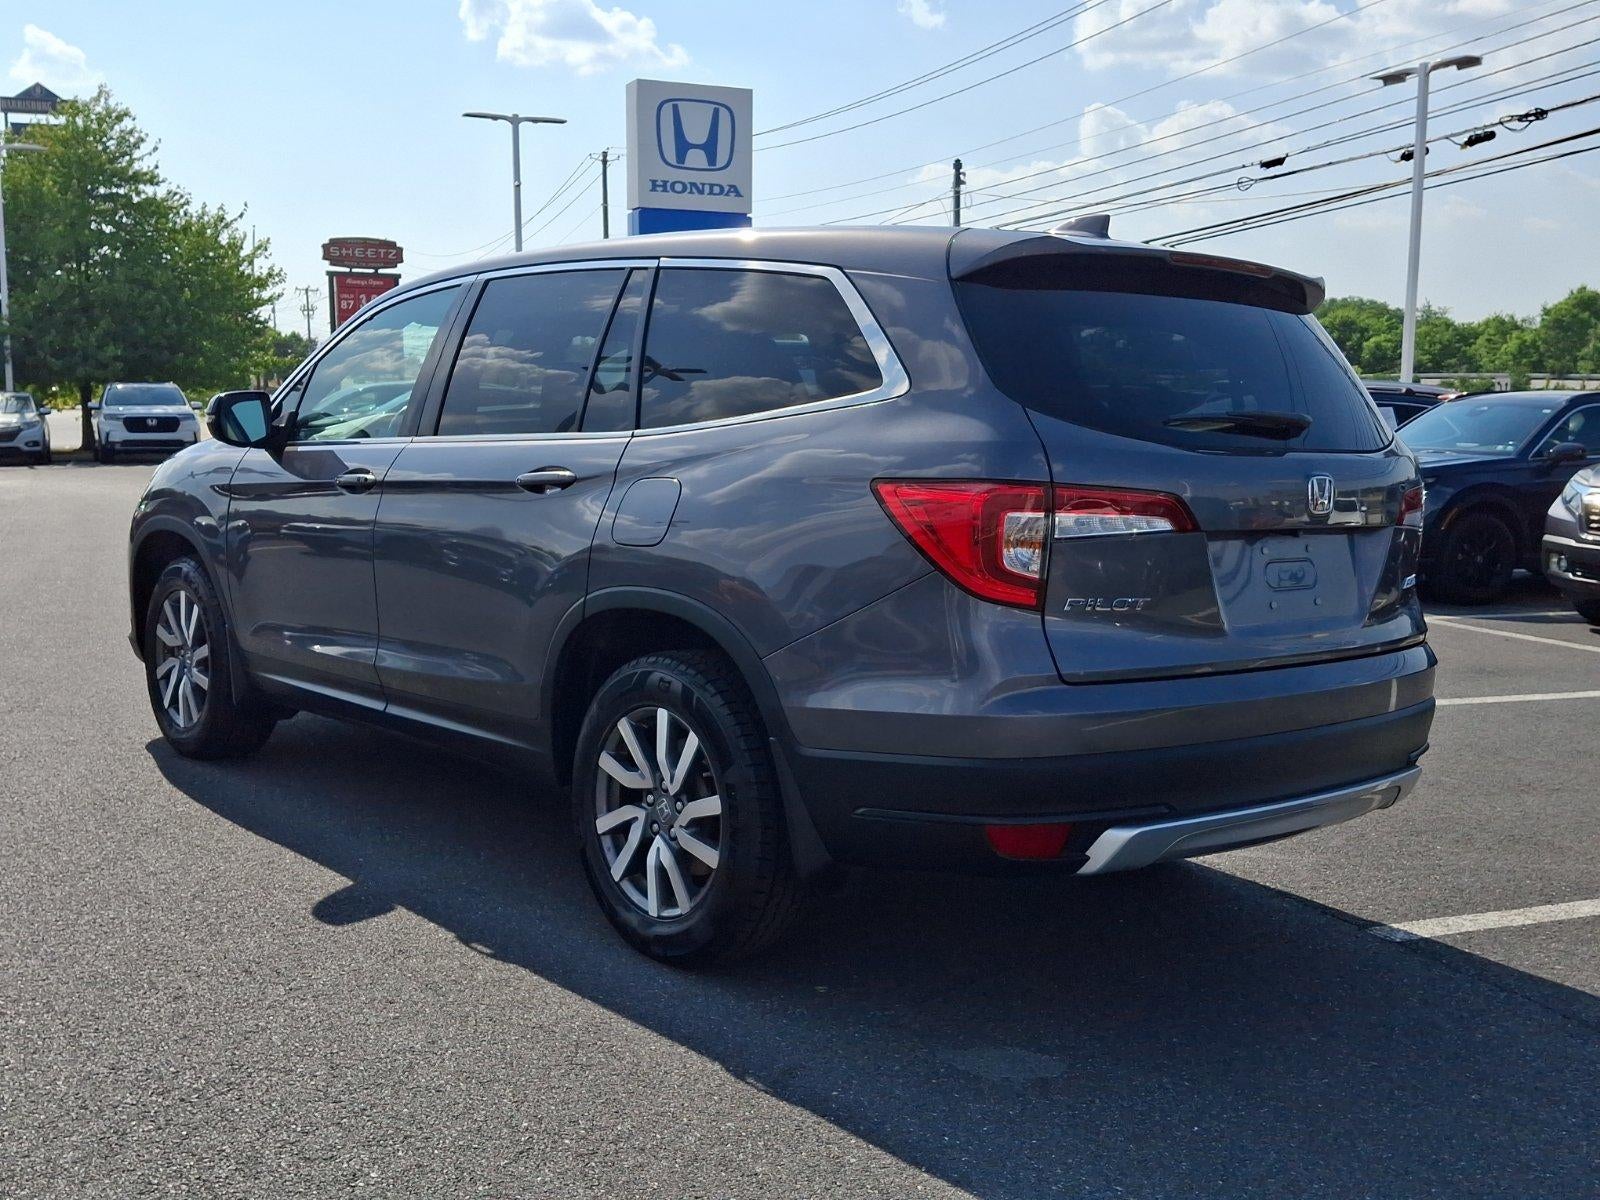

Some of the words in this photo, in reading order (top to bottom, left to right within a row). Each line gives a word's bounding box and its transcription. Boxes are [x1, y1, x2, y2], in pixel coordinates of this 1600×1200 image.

[648, 179, 744, 198] HONDA
[329, 246, 397, 259] SHEETZ
[340, 300, 354, 310] 87
[1063, 598, 1151, 611] PILOT
